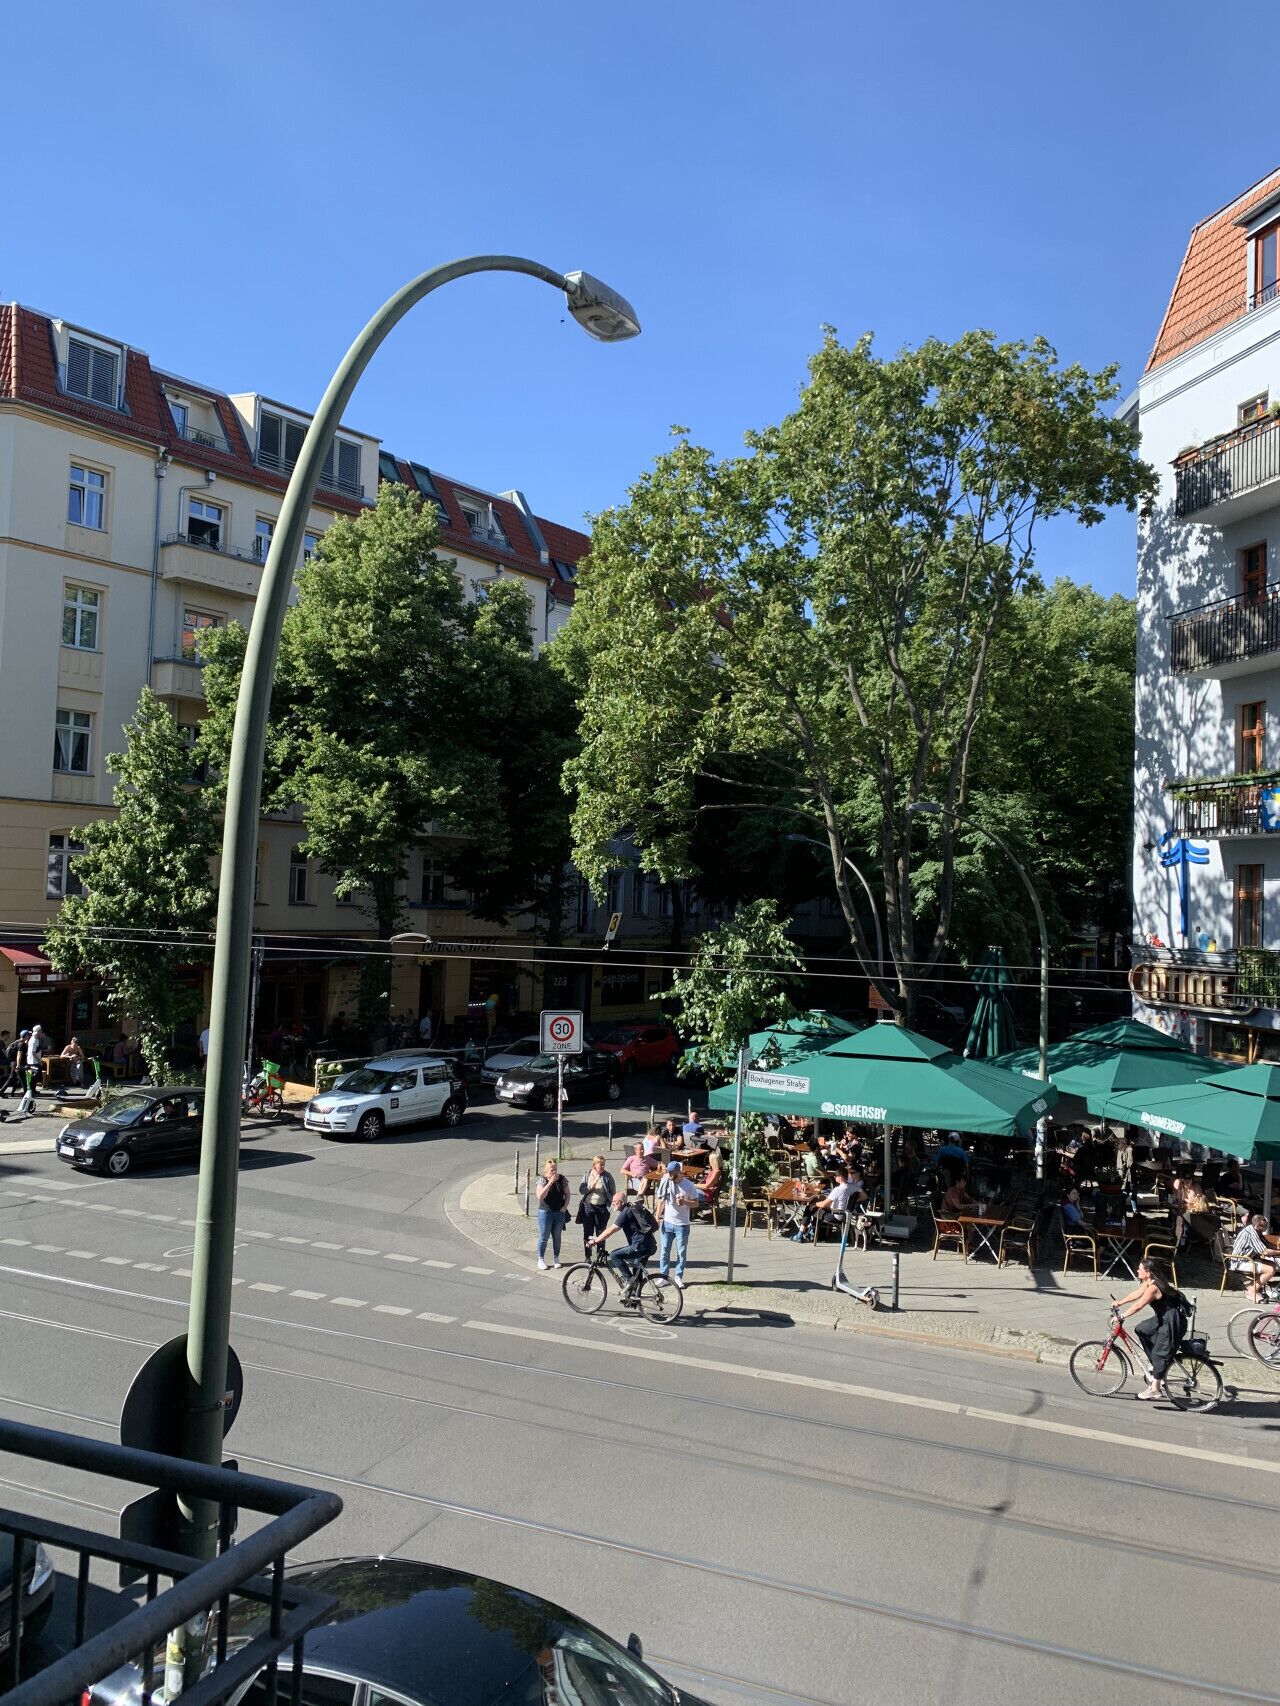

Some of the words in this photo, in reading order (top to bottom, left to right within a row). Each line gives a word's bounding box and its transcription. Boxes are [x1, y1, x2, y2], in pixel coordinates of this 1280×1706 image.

[555, 1023, 570, 1035] 30
[552, 1042, 572, 1050] ZONE
[750, 1074, 785, 1086] Boxhagener
[786, 1078, 806, 1089] Straße
[834, 1102, 888, 1120] SOMERSBY
[1148, 1113, 1186, 1135] SOMERSBY
